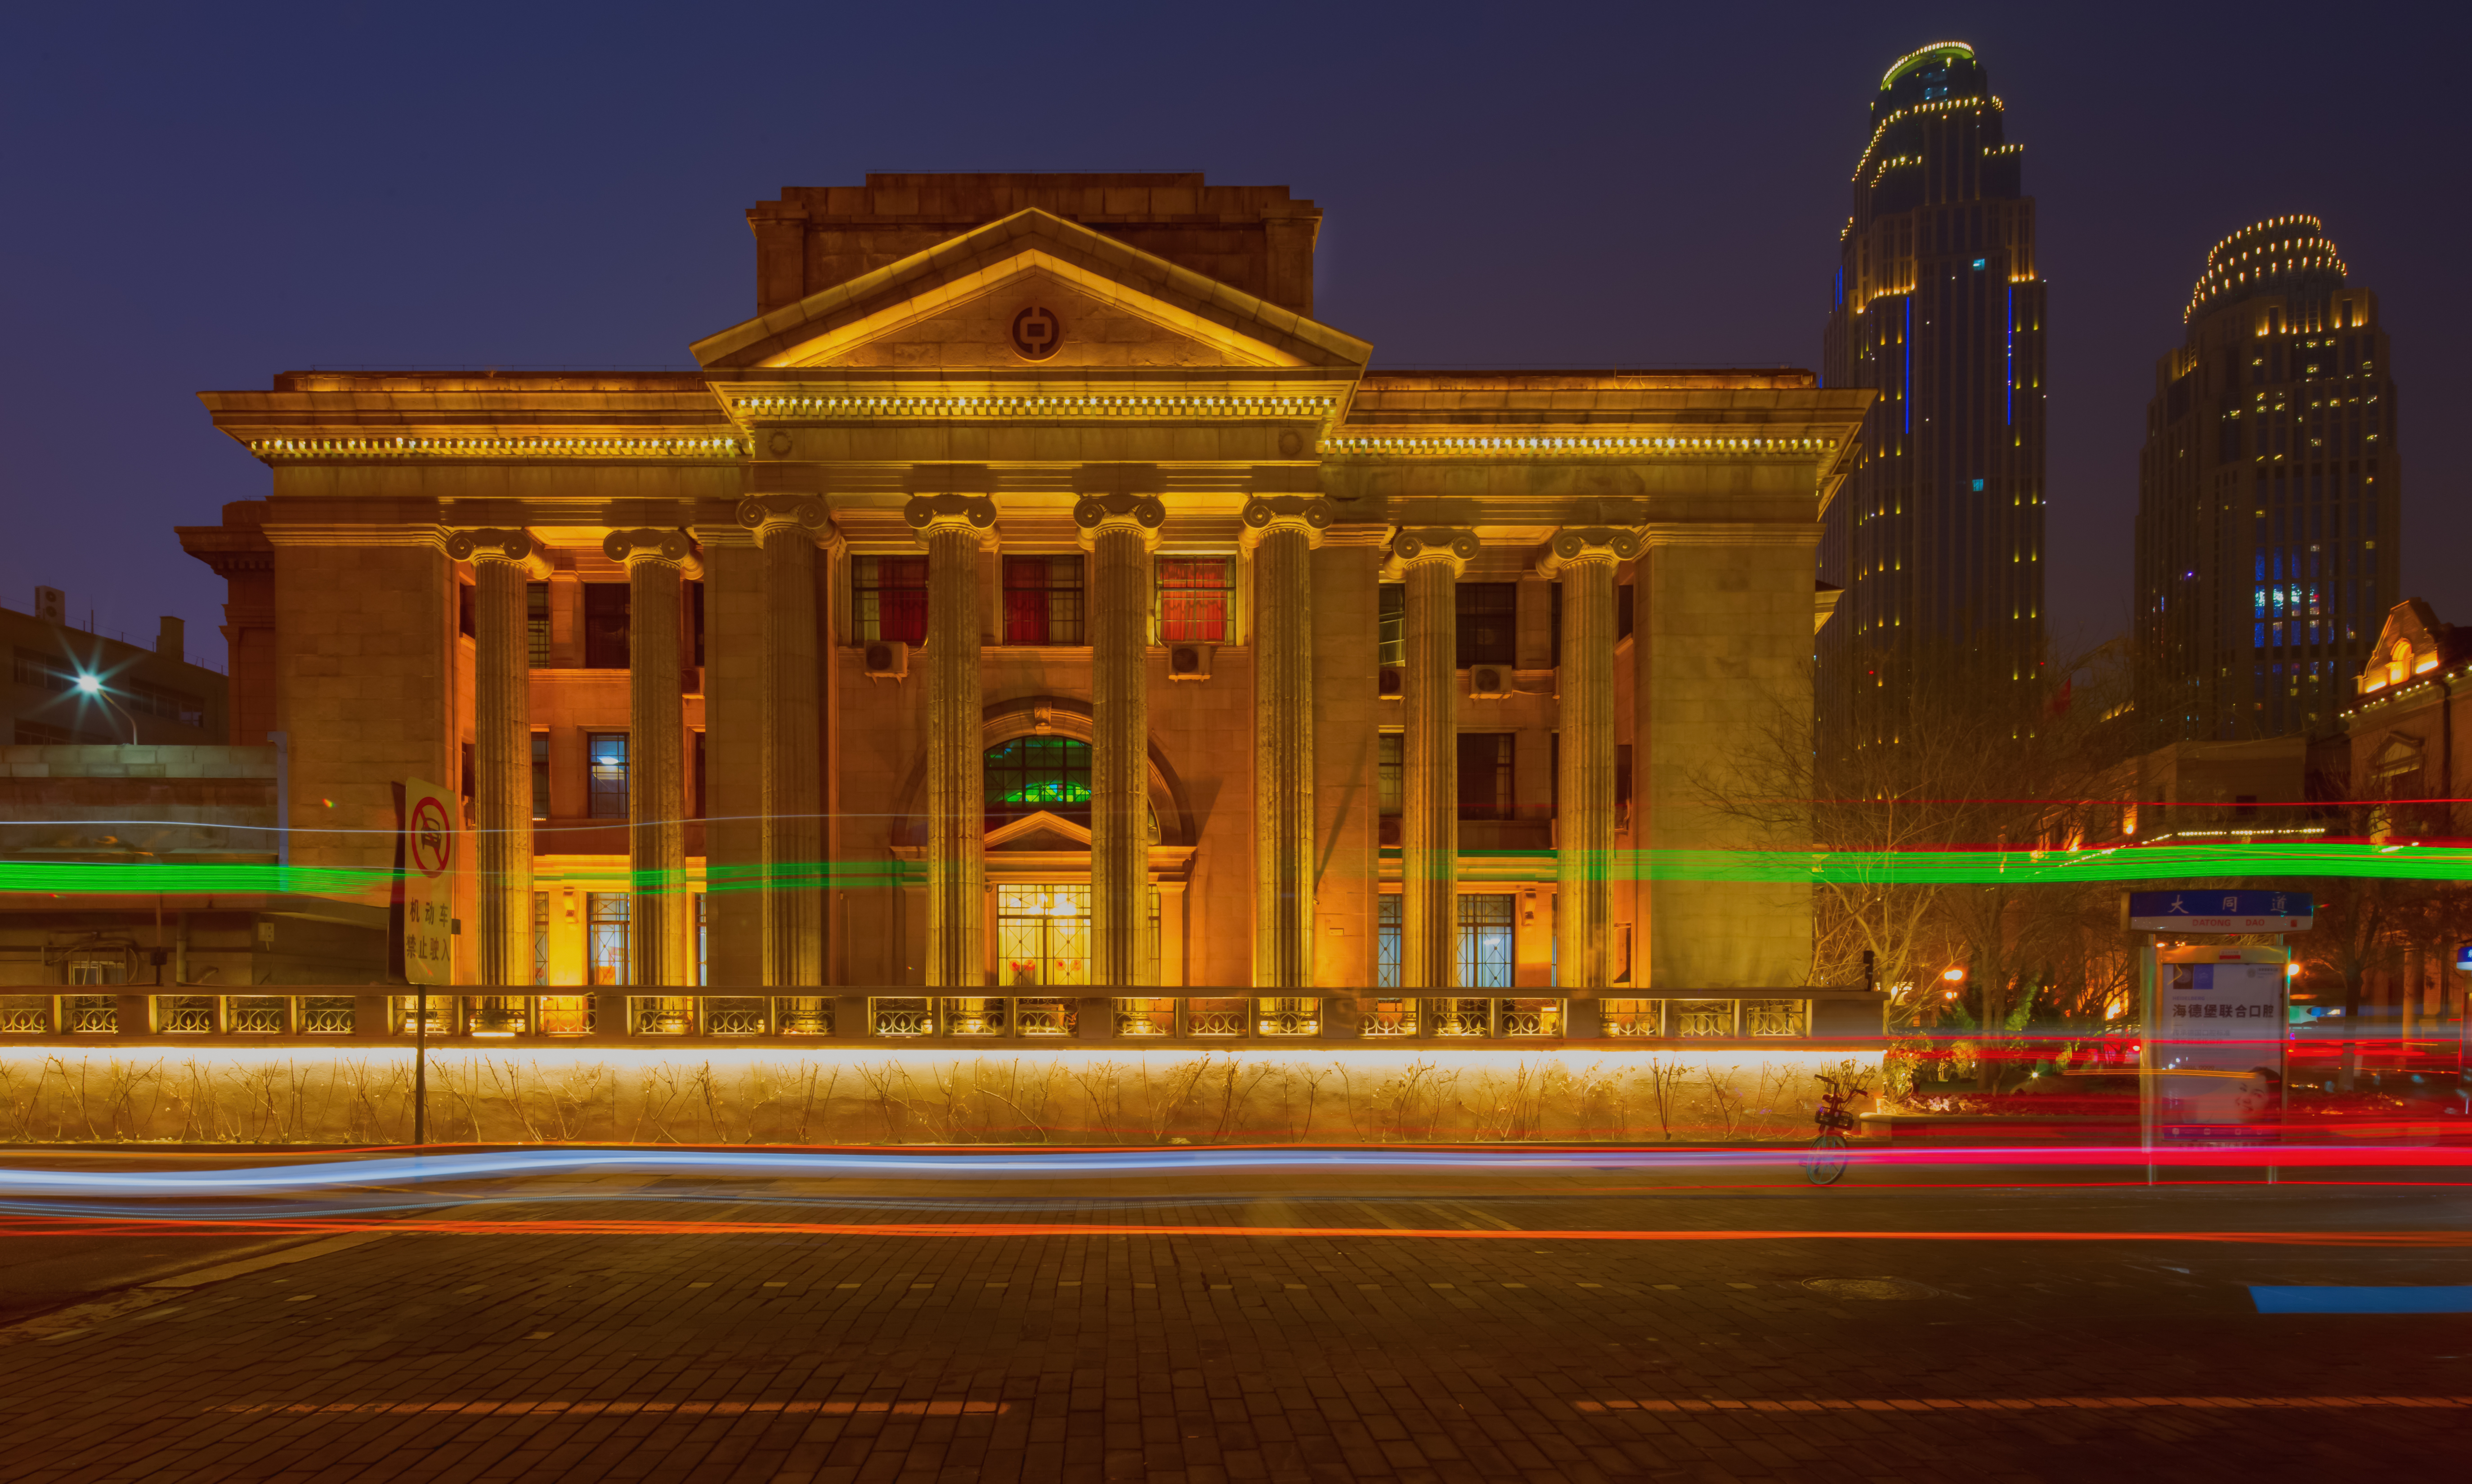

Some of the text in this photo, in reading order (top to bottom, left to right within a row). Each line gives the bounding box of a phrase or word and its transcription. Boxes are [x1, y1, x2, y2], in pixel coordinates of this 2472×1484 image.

[410, 897, 448, 927] 机动车
[2167, 895, 2288, 913] 大同道
[2192, 919, 2231, 927] DATONG
[406, 934, 450, 962] 禁止驶入
[2172, 1004, 2274, 1018] 海德堡联合口腔
